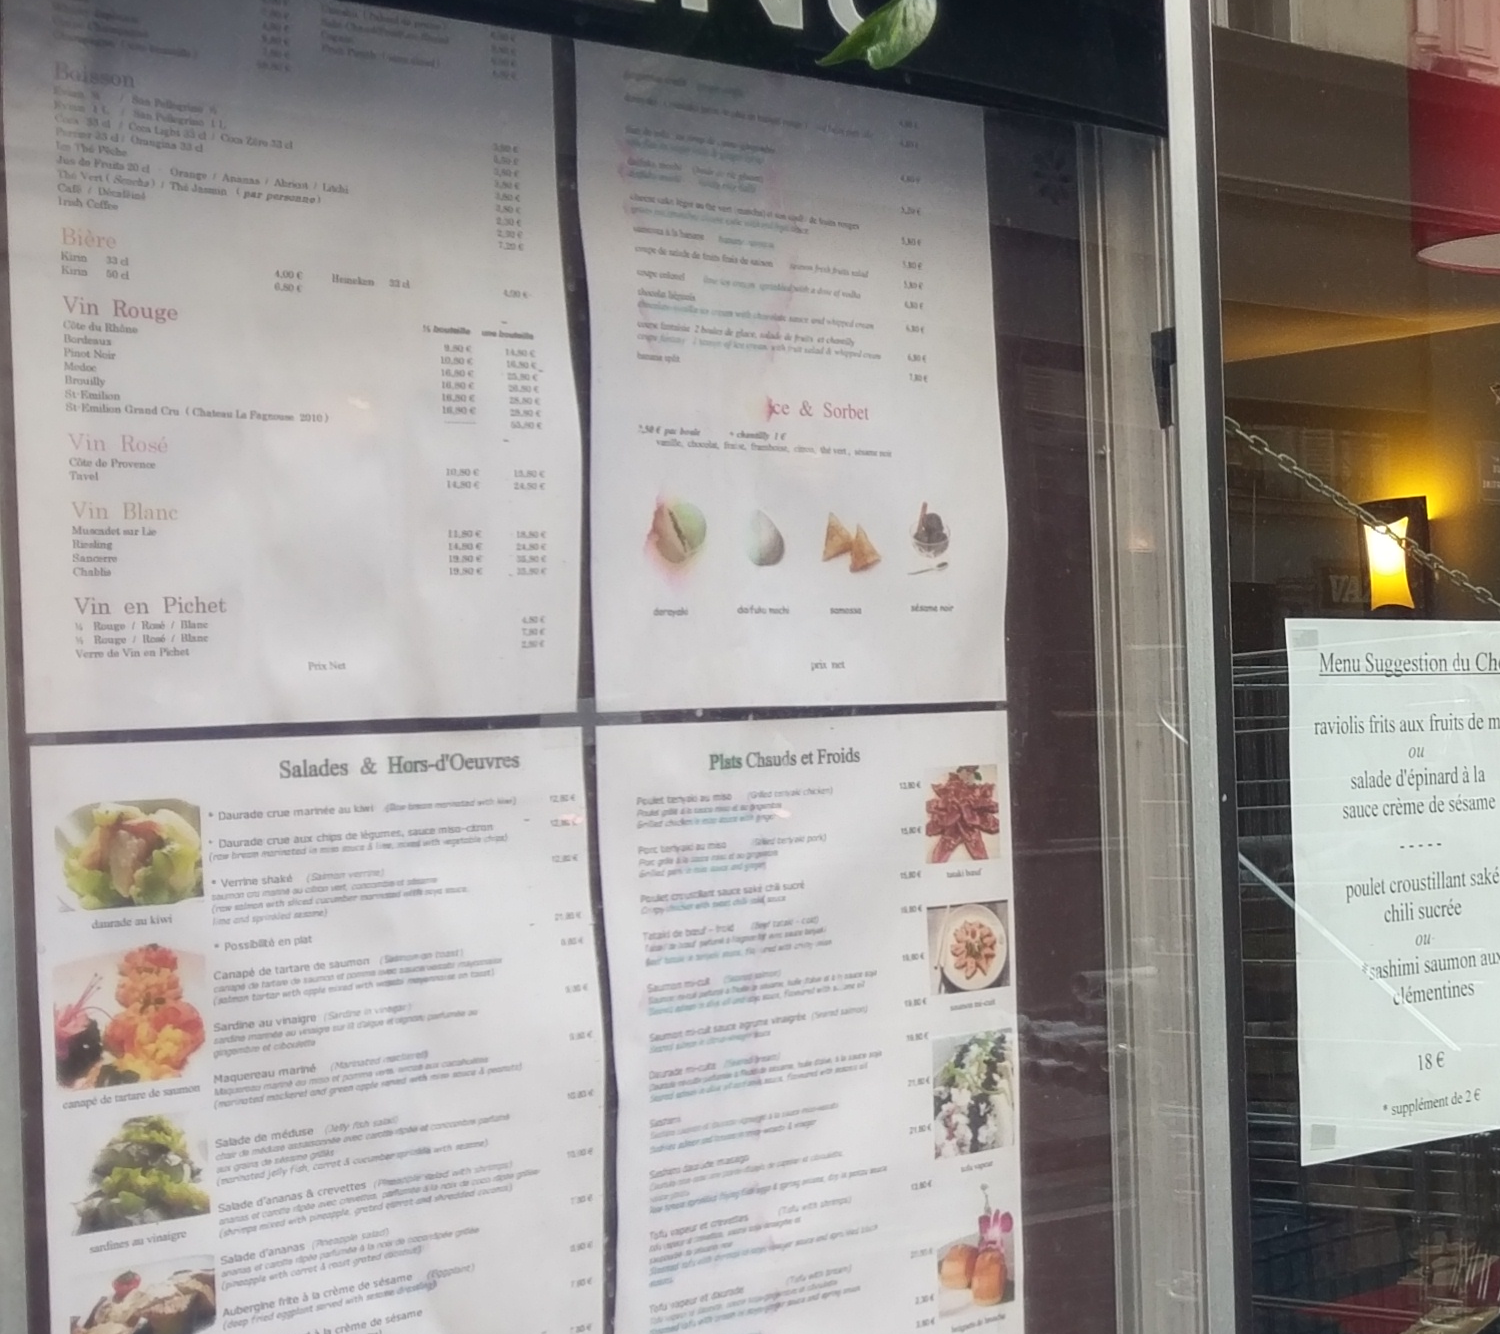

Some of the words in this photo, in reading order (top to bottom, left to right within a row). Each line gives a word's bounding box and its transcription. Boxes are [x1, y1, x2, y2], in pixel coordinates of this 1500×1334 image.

[55, 59, 138, 89] Boisson
[62, 227, 116, 249] Bière
[63, 295, 100, 316] Vin
[112, 299, 178, 324] Rouge
[88, 321, 102, 332] du
[64, 333, 112, 346] Bordeaux
[64, 347, 91, 359] Pinot
[93, 349, 116, 360] Noir
[65, 375, 106, 389] Brouilly
[799, 400, 813, 417] &
[823, 401, 869, 421] Sorbet
[68, 433, 106, 452] Vin
[122, 434, 168, 453] Rosé
[69, 470, 99, 481] Tavel
[72, 501, 109, 520] Vin
[123, 501, 178, 521] Blanc
[72, 539, 113, 551] Riesling
[72, 553, 118, 563] Sancerre
[72, 567, 112, 577] Chablis
[74, 597, 111, 615] Vin
[124, 602, 149, 615] en
[163, 596, 227, 614] Pichet
[1320, 652, 1361, 673] Menu
[1363, 652, 1449, 678] Suggestion
[1452, 652, 1470, 672] du
[1314, 715, 1365, 735] raviolis
[1369, 714, 1396, 734] frits
[1399, 719, 1425, 733] aux
[1430, 713, 1464, 732] fruits
[1468, 712, 1484, 730] de
[709, 753, 743, 771] Plats
[745, 750, 797, 769] Chauds
[800, 751, 814, 765] et
[816, 747, 860, 765] Froids
[1408, 747, 1424, 759] ou
[279, 758, 349, 779] Salades
[360, 757, 378, 775] &
[388, 753, 520, 774] Hors-d'Oeuvres
[1350, 769, 1392, 790] salade
[1396, 766, 1459, 791] d'épinard
[1462, 765, 1470, 784] à
[1473, 765, 1486, 783] la
[1342, 804, 1379, 819] sauce
[1382, 797, 1424, 817] crème
[1428, 795, 1445, 813] de
[1448, 794, 1496, 813] sésame
[1346, 877, 1386, 904] poulet
[1389, 871, 1466, 894] croustillant
[1470, 866, 1500, 887] saké
[134, 918, 148, 926] au
[150, 915, 172, 925] kiwi
[1384, 901, 1414, 923] chili
[1418, 898, 1462, 920] sucrée
[1415, 933, 1431, 946] ou
[1424, 955, 1477, 973] saumon
[1393, 980, 1475, 1006] clémentines
[1418, 1053, 1433, 1071] 18
[1436, 1051, 1444, 1068] €
[62, 1097, 98, 1109] canapé
[100, 1094, 112, 1105] de
[114, 1092, 146, 1103] tartare
[148, 1088, 160, 1098] de
[162, 1085, 200, 1096] saumon
[1391, 1096, 1449, 1118] supplément
[1450, 1091, 1463, 1105] de
[1465, 1089, 1472, 1103] 2
[1474, 1088, 1481, 1101] €
[89, 1240, 130, 1254] sardines
[131, 1238, 144, 1247] au
[146, 1231, 187, 1243] vinaigre
